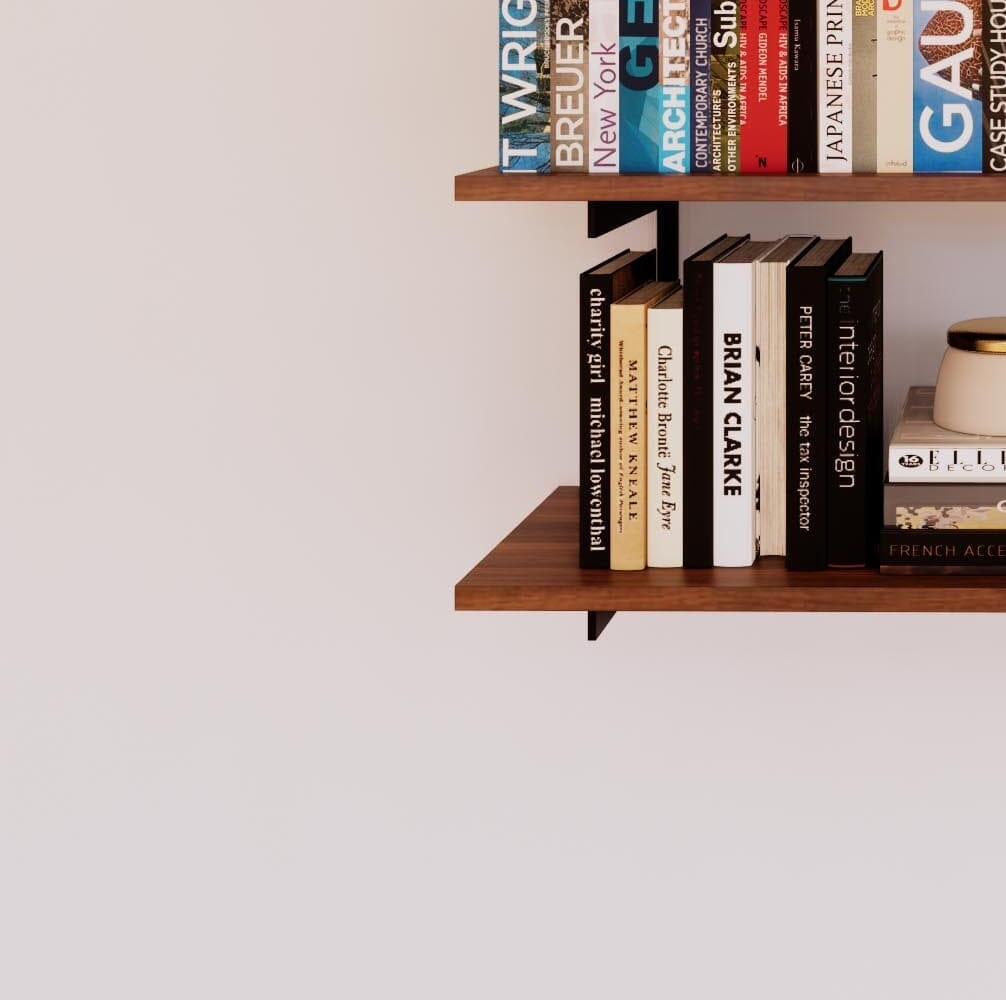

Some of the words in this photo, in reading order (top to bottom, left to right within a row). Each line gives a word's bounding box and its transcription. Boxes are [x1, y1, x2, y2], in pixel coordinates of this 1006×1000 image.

[696, 18, 708, 66] CHURCH
[759, 33, 767, 65] GIDEON
[779, 33, 787, 48] HIV
[556, 17, 584, 167] BREUER
[591, 43, 617, 99] York
[759, 68, 767, 102] MENDEL
[779, 60, 787, 81] AIDS
[779, 82, 787, 93] IN
[696, 70, 708, 168] CONTEMPORARY
[728, 62, 737, 136] ENVIRONMENTS
[779, 94, 787, 126] AFRICA
[827, 53, 847, 161] JAPANESE
[593, 108, 617, 167] New
[713, 89, 722, 171] ARCHITECTURE'S
[728, 140, 737, 171] OTHER
[588, 288, 606, 348] charity
[799, 306, 813, 349] PETER
[588, 351, 606, 383] girl
[657, 345, 673, 409] Charlotte
[723, 333, 742, 403] BRIAN
[799, 355, 813, 400] CAREY
[628, 360, 638, 445] MATTHEW
[799, 416, 813, 436] the
[590, 397, 606, 468] michael
[657, 411, 673, 458] Brontë
[723, 412, 742, 496] CLARKE
[799, 442, 811, 463] tax
[628, 454, 638, 520] KNEALE
[656, 462, 676, 497] Jane
[798, 468, 813, 531] inspector
[590, 470, 606, 551] lowenthal
[657, 499, 676, 531] Eyre
[889, 544, 956, 557] FRENCH
